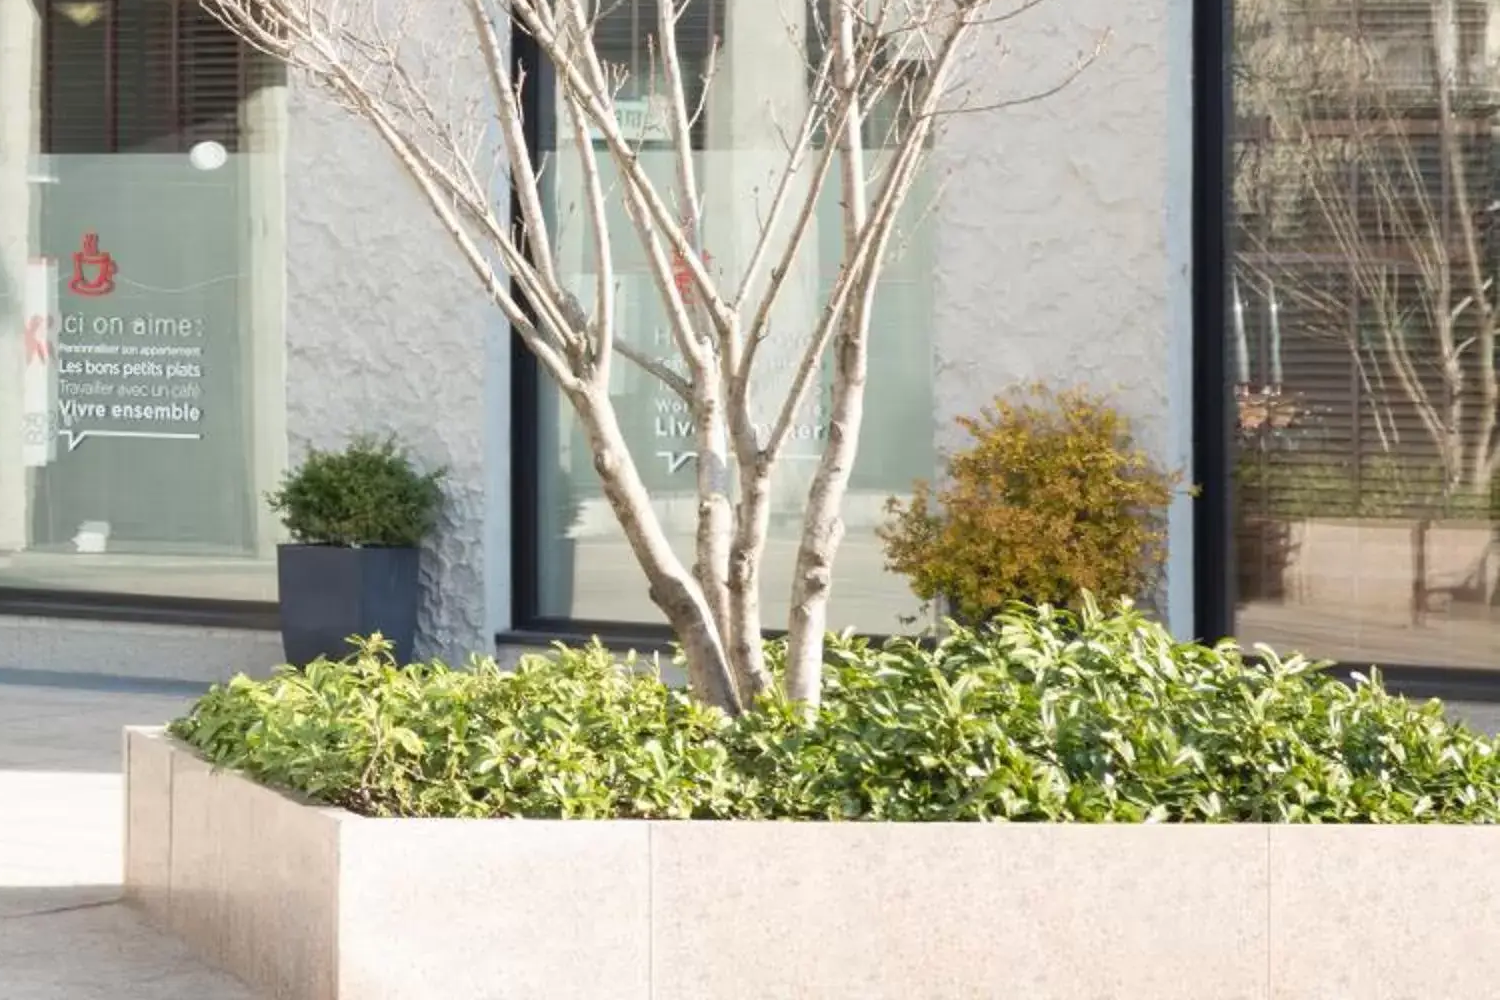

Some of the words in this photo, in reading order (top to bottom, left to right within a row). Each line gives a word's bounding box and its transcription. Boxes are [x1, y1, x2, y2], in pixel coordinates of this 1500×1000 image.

[93, 316, 123, 335] on
[59, 359, 83, 374] Les
[85, 360, 120, 375] bons
[123, 361, 163, 379] petits
[166, 363, 201, 379] plats
[58, 400, 106, 418] Vivre
[111, 402, 201, 422] ensemble
[655, 416, 696, 437] Liv
